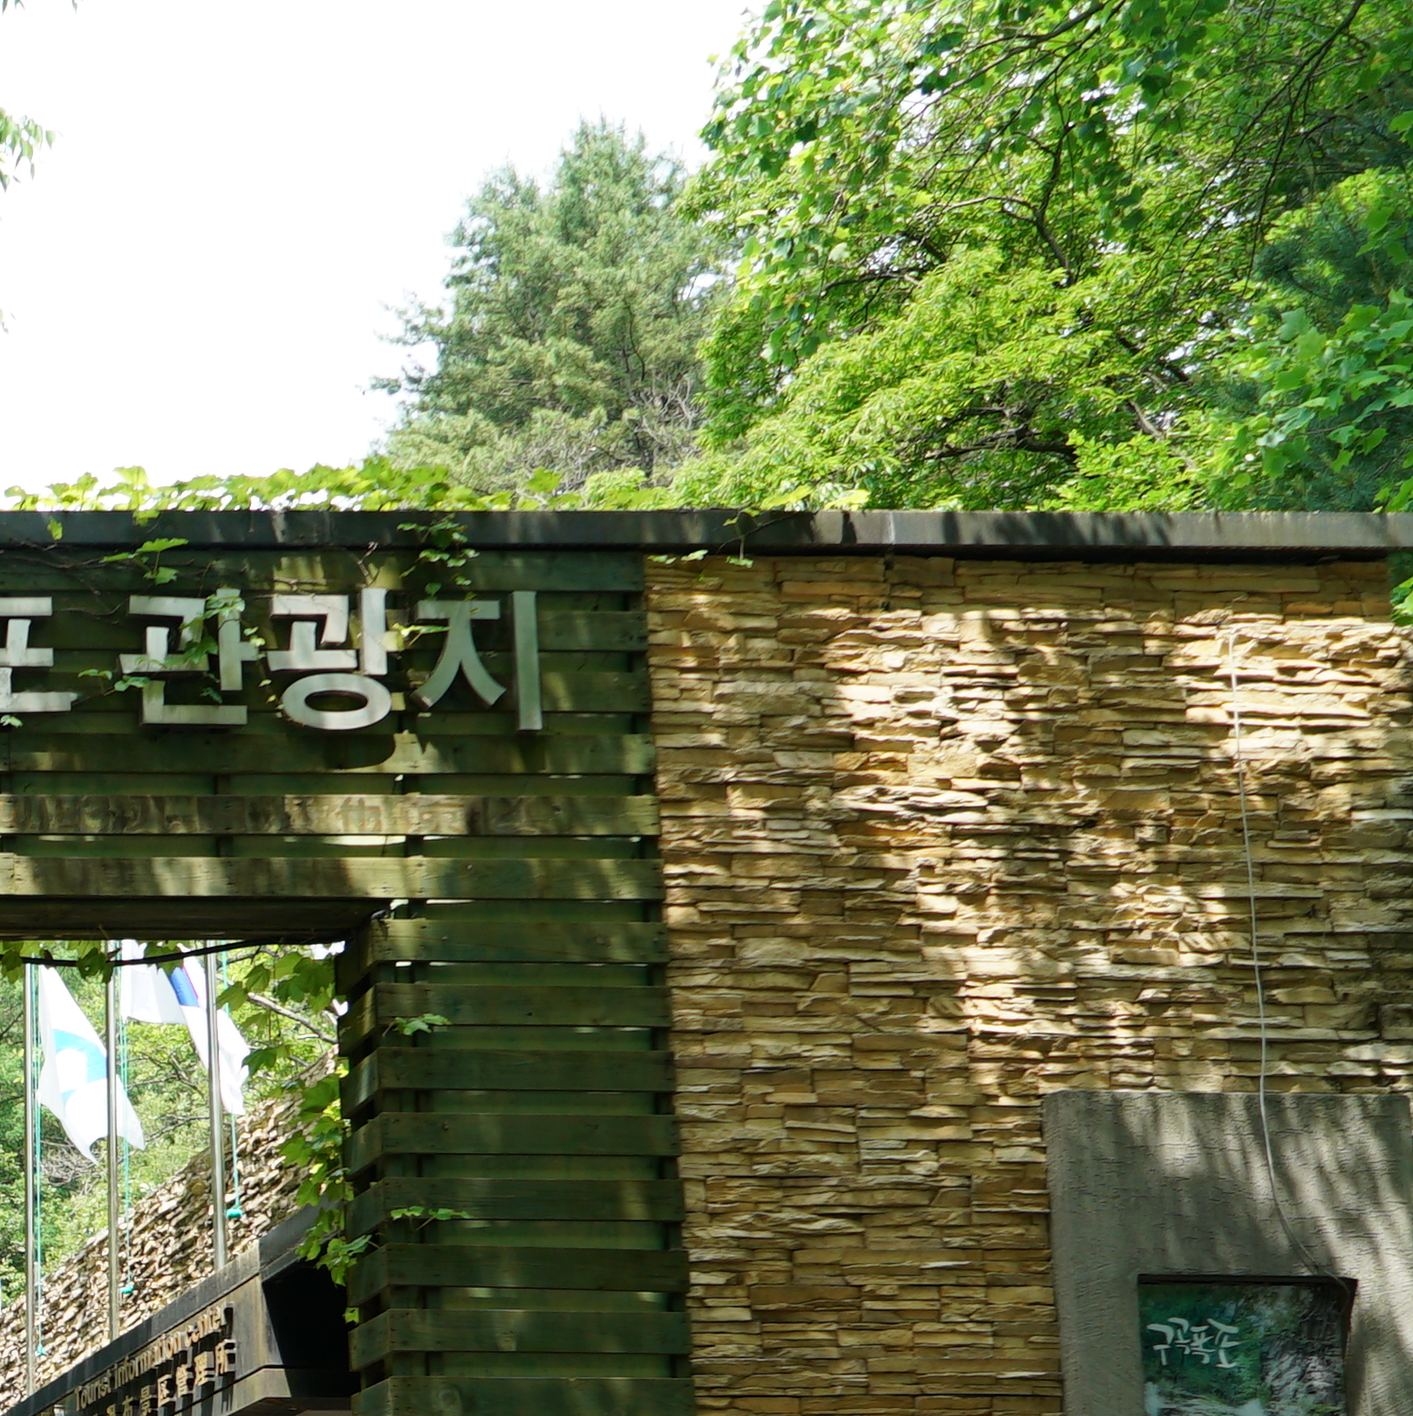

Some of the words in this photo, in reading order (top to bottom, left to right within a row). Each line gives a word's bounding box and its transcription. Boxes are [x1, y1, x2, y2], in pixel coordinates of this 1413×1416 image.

[120, 587, 542, 733] 관광지
[74, 1368, 112, 1412] Tourist
[113, 1332, 184, 1390] information
